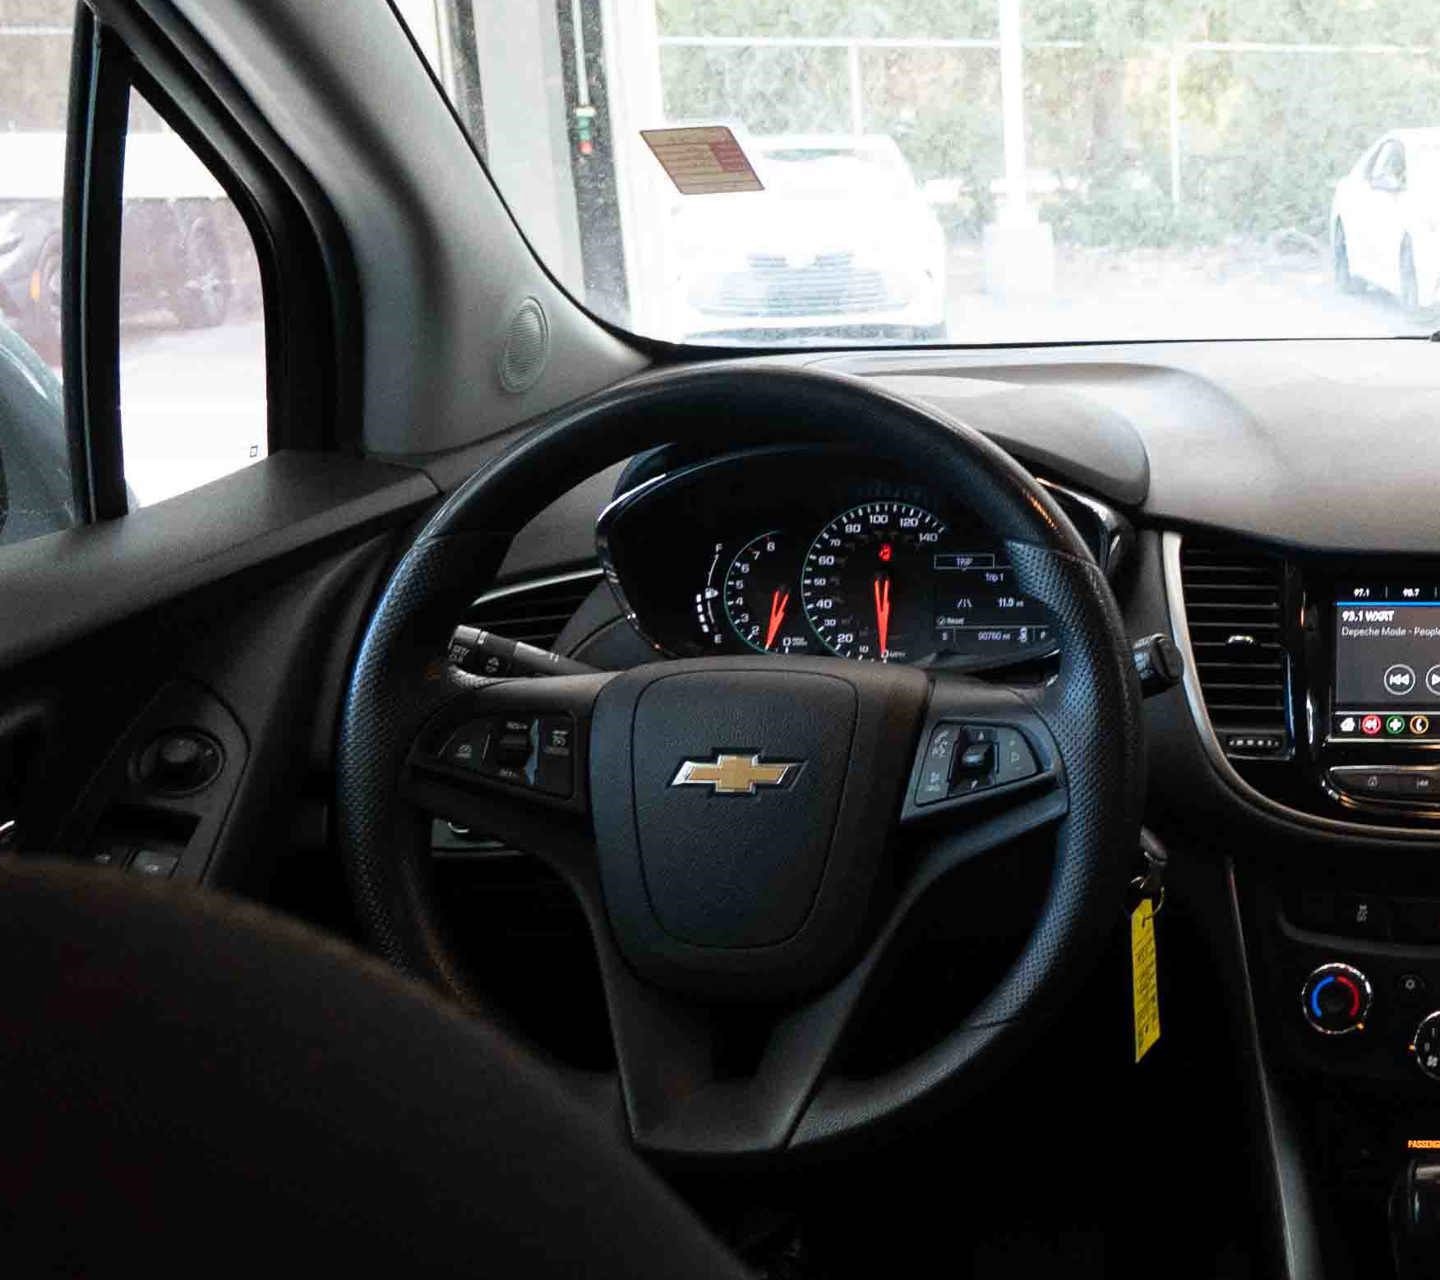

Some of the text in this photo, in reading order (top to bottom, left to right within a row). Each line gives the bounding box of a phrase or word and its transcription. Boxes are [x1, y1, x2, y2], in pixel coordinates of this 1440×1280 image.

[869, 514, 889, 524] 100
[899, 517, 919, 528] 120
[844, 523, 862, 534] 80
[829, 538, 841, 547] 70
[919, 532, 938, 543] 140
[752, 551, 761, 560] 7
[817, 556, 835, 566] 60
[740, 563, 750, 574] 6
[735, 580, 745, 590] 5
[813, 577, 827, 587] 50
[735, 596, 744, 606] 4
[815, 599, 833, 610] 40
[740, 613, 750, 622] 3
[824, 618, 837, 627] 30
[751, 625, 761, 635] 2
[1341, 626, 1379, 638] Depeche
[1380, 626, 1405, 636] Mode
[782, 636, 791, 647] 0
[836, 633, 854, 644] 20
[859, 644, 869, 654] 10
